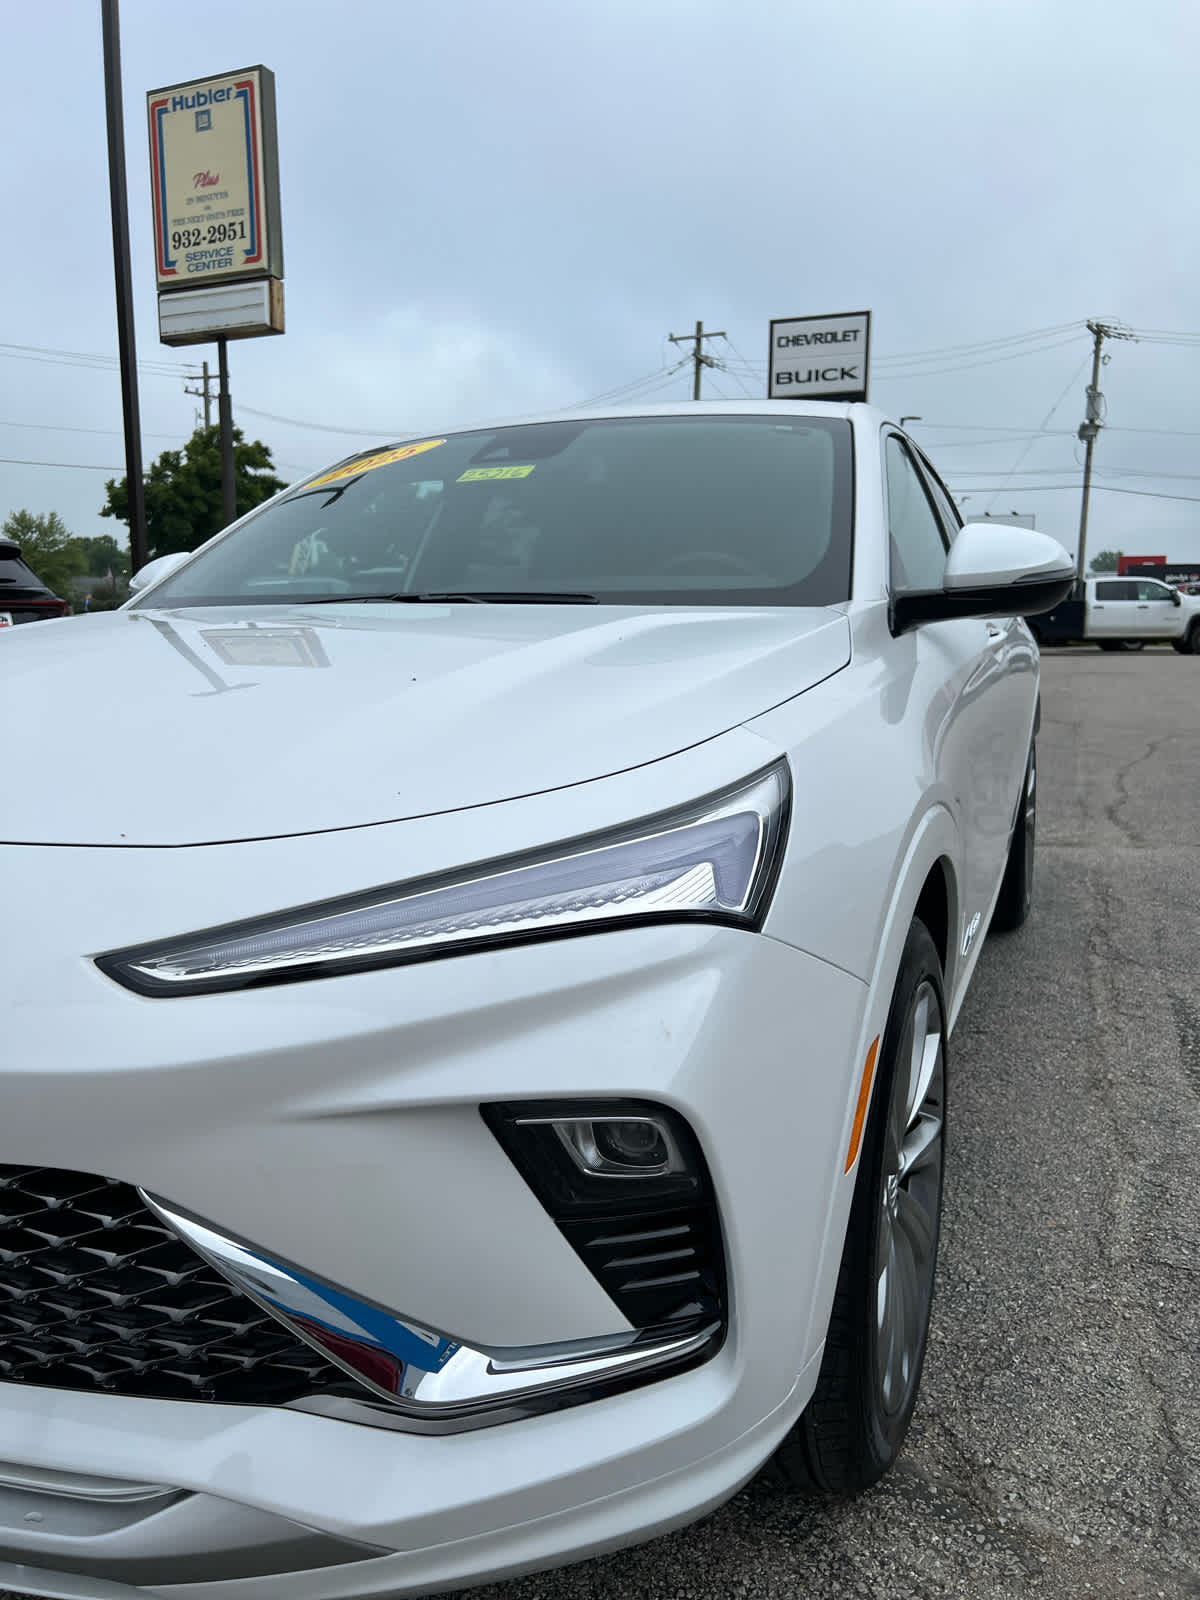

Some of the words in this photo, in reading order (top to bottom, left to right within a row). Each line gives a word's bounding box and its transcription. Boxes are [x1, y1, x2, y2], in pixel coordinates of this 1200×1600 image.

[172, 88, 232, 111] Hubler
[192, 169, 220, 189] Plus
[172, 221, 246, 249] 932-2951
[185, 247, 233, 262] SERVICE
[187, 257, 233, 273] CENTER
[776, 329, 860, 348] CHEVROLET
[775, 366, 859, 385] BUICK
